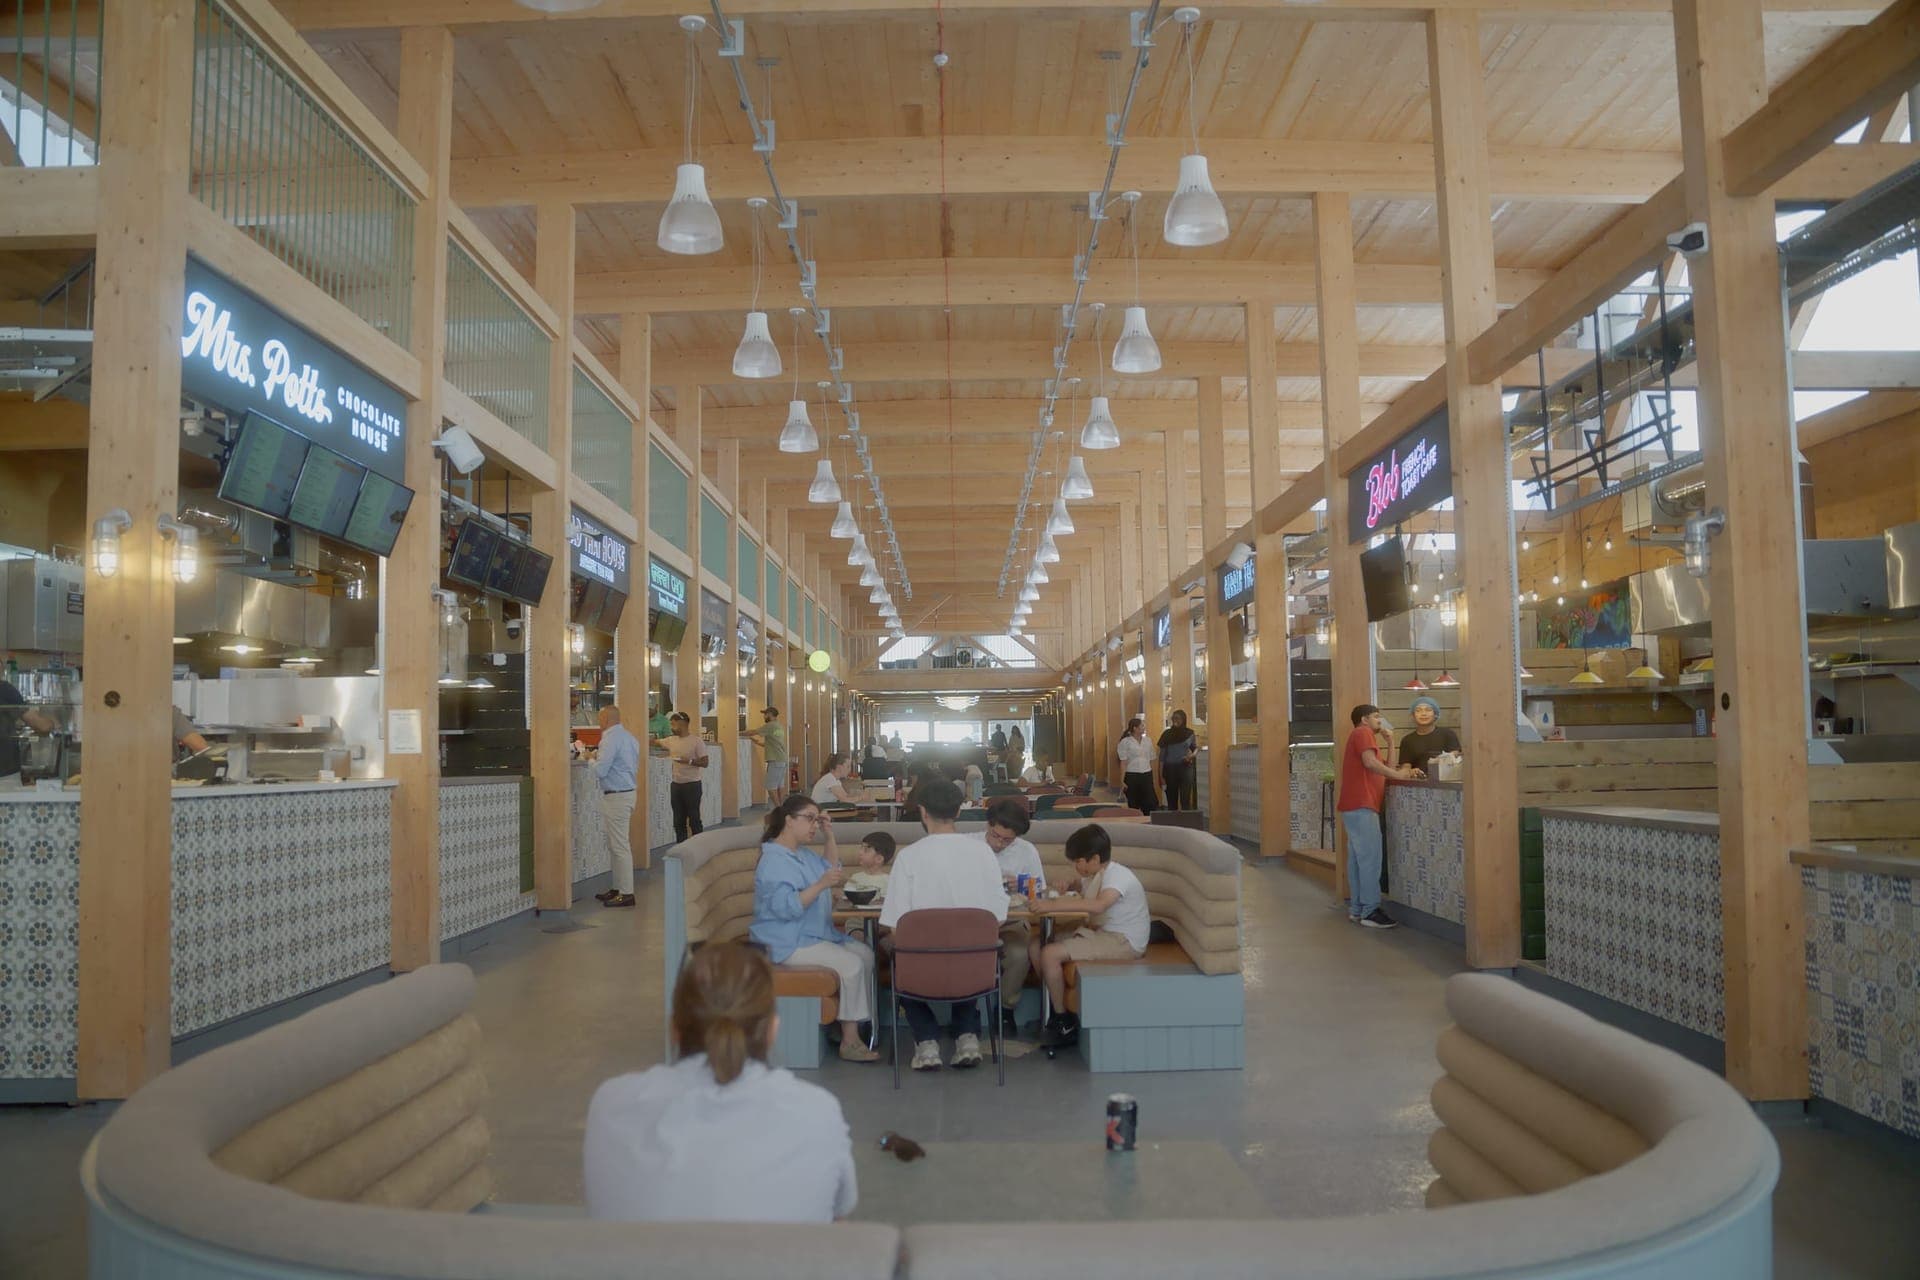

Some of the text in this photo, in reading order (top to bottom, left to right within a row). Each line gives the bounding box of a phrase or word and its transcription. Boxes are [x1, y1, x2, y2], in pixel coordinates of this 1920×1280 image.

[181, 291, 333, 424] Mrs. Potts
[337, 385, 401, 437] CHOCOLATE
[351, 418, 389, 453] HOUSE
[1401, 437, 1426, 480] FRENCH
[1401, 465, 1421, 500] TOAST
[602, 535, 626, 572] HOUSE
